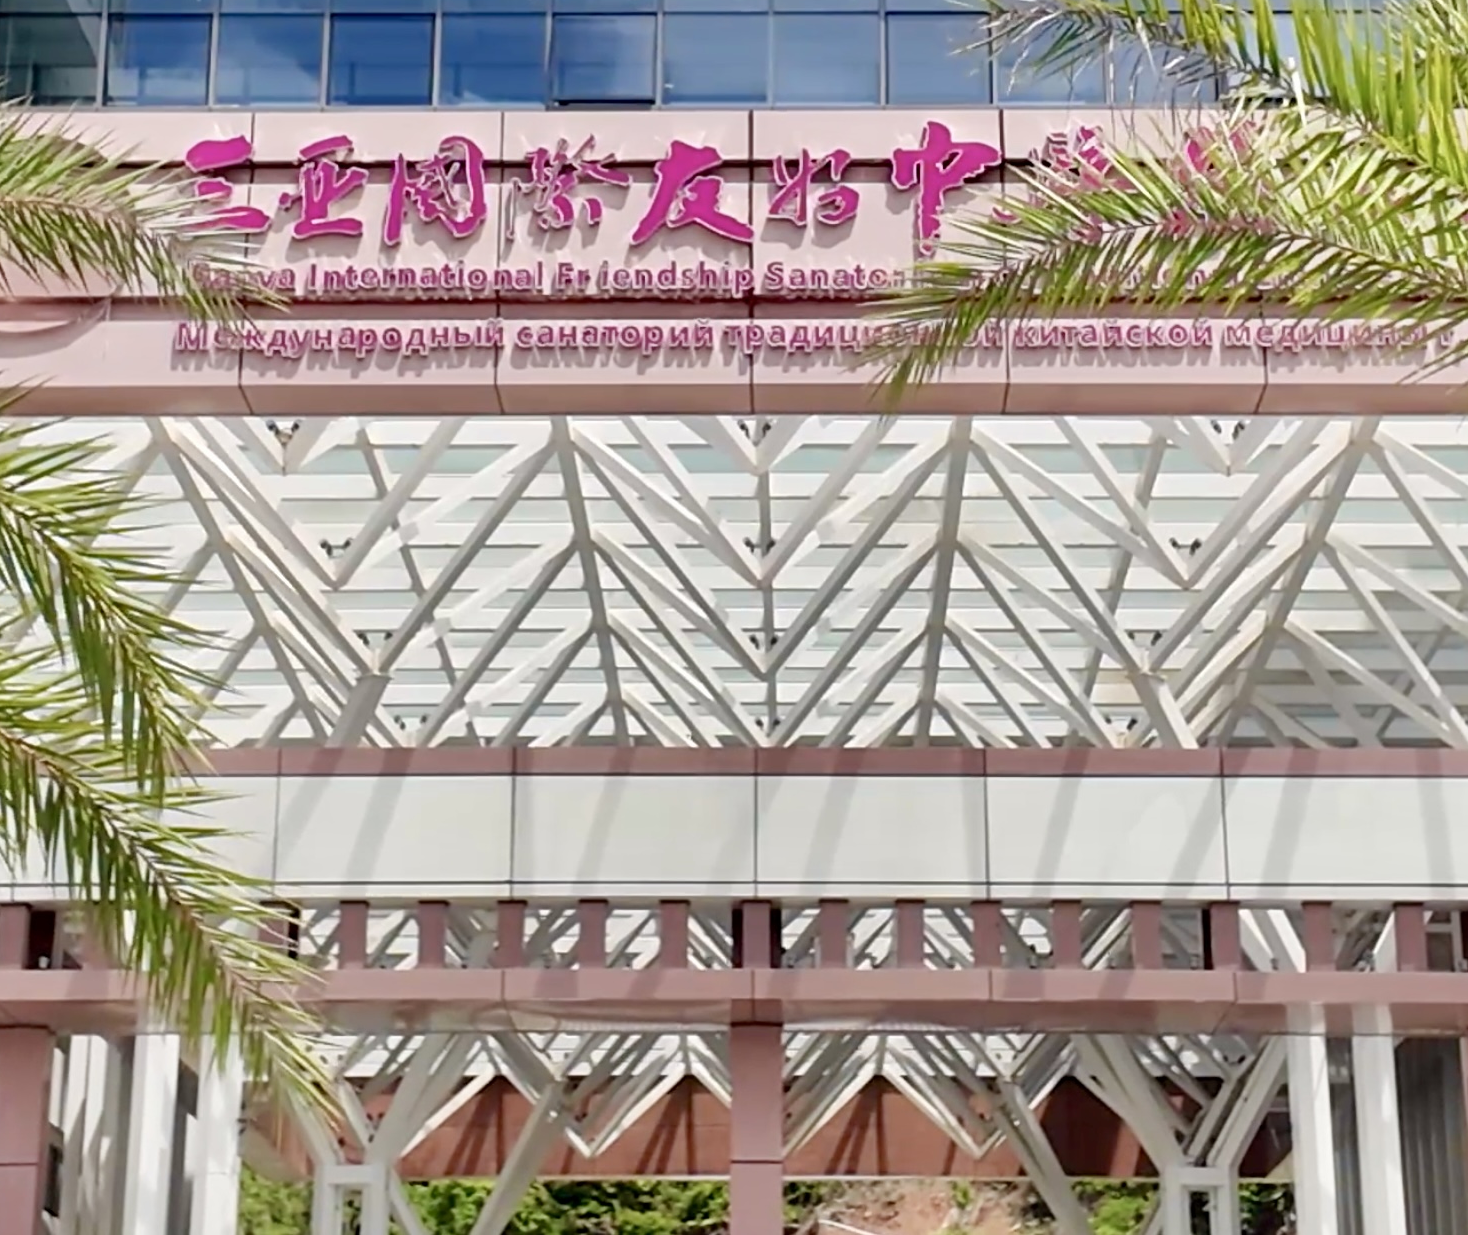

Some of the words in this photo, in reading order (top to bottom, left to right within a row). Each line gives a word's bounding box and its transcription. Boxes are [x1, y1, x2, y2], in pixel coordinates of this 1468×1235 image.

[308, 260, 544, 291] International
[556, 259, 753, 295] Friendship
[516, 318, 715, 355] санаторий
[1014, 318, 1214, 348] китайской
